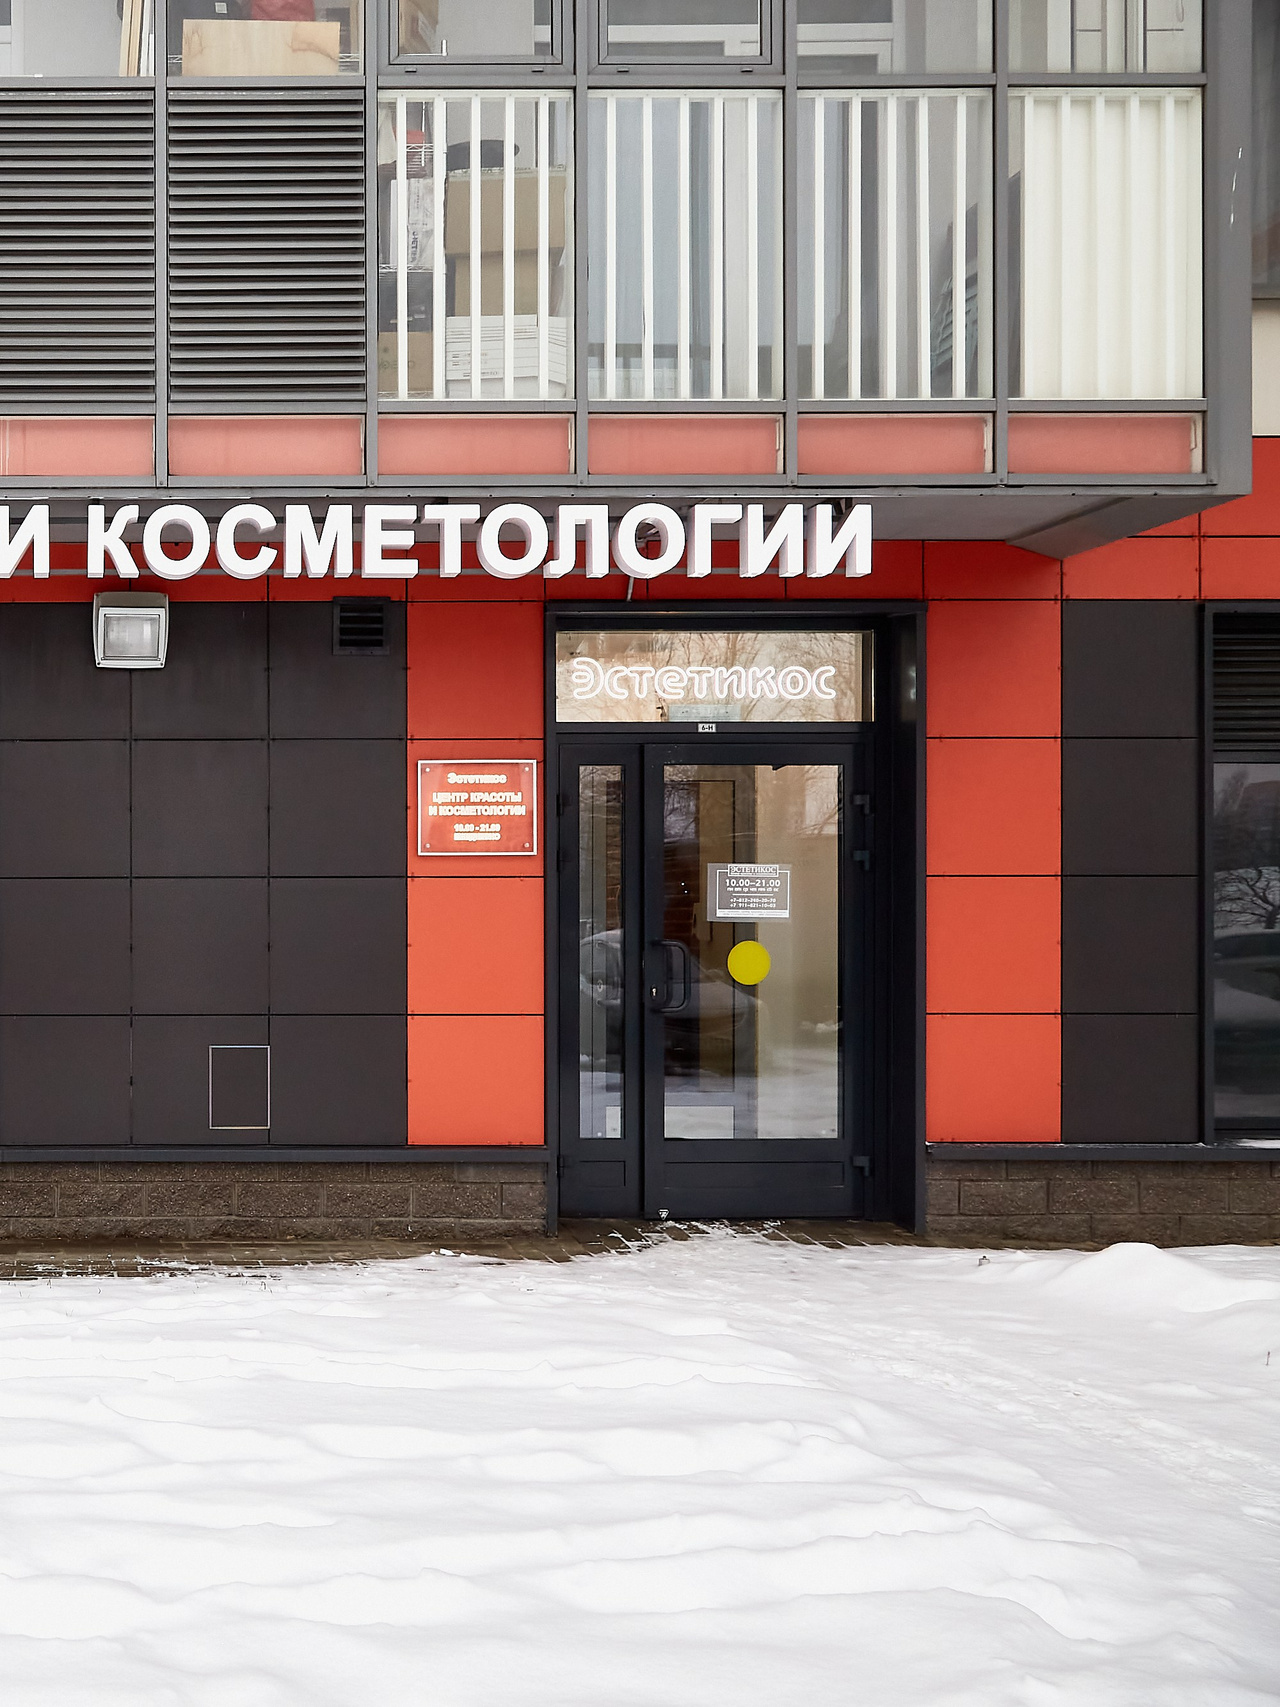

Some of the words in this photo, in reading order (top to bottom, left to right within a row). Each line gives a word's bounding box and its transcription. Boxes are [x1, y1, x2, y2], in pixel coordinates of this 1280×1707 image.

[86, 502, 874, 580] КОСМЕТОЛОГИИ
[573, 657, 837, 700] Эстетикос
[432, 792, 469, 804] ЦЕНТР
[470, 791, 522, 803] КРАСОТЫ
[439, 805, 526, 816] КОСМЕТОЛОГИИ
